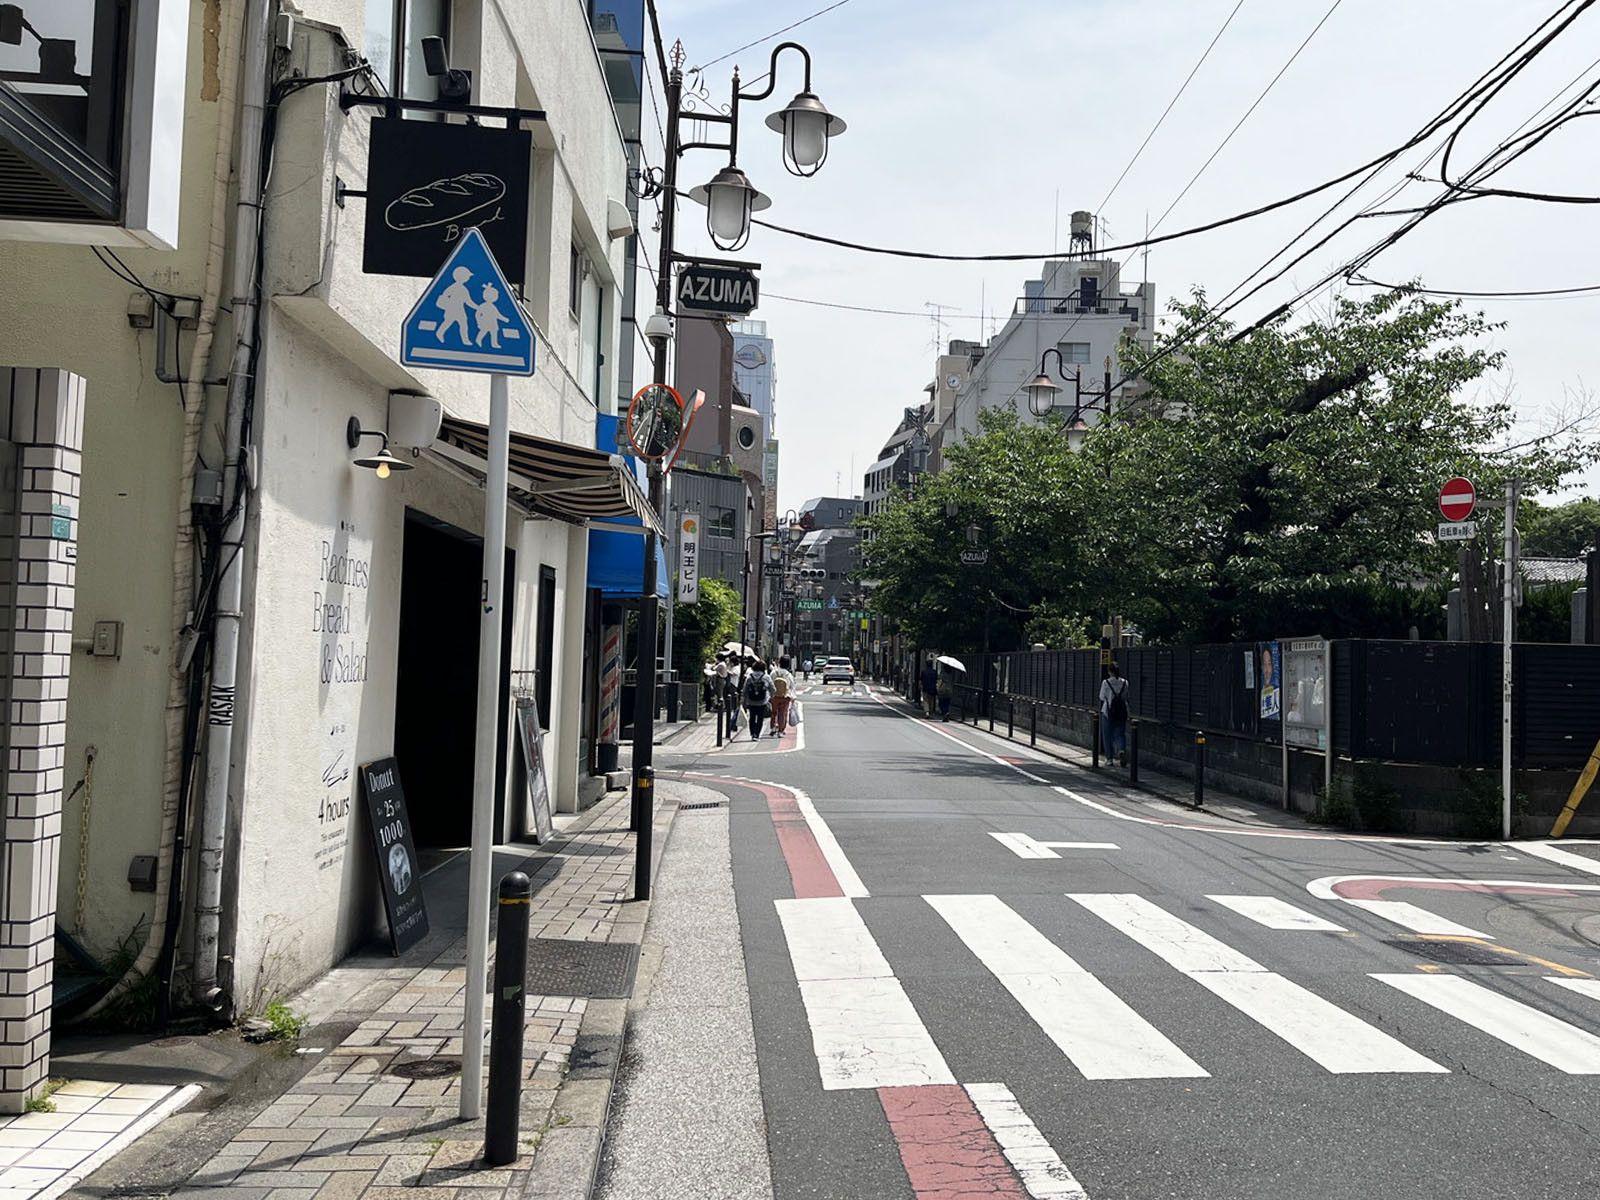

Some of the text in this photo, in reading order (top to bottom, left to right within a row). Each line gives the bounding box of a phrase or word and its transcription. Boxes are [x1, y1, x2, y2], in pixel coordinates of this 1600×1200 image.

[680, 275, 754, 305] AZUMA
[320, 540, 368, 589] Racines
[682, 542, 696, 594] 明王ビル
[312, 591, 351, 633] Bread
[797, 601, 822, 610] AZUMA
[320, 641, 368, 684] & Salad
[209, 684, 235, 726] RASAK
[318, 795, 349, 825] 4 hours
[379, 819, 403, 847] 1000
